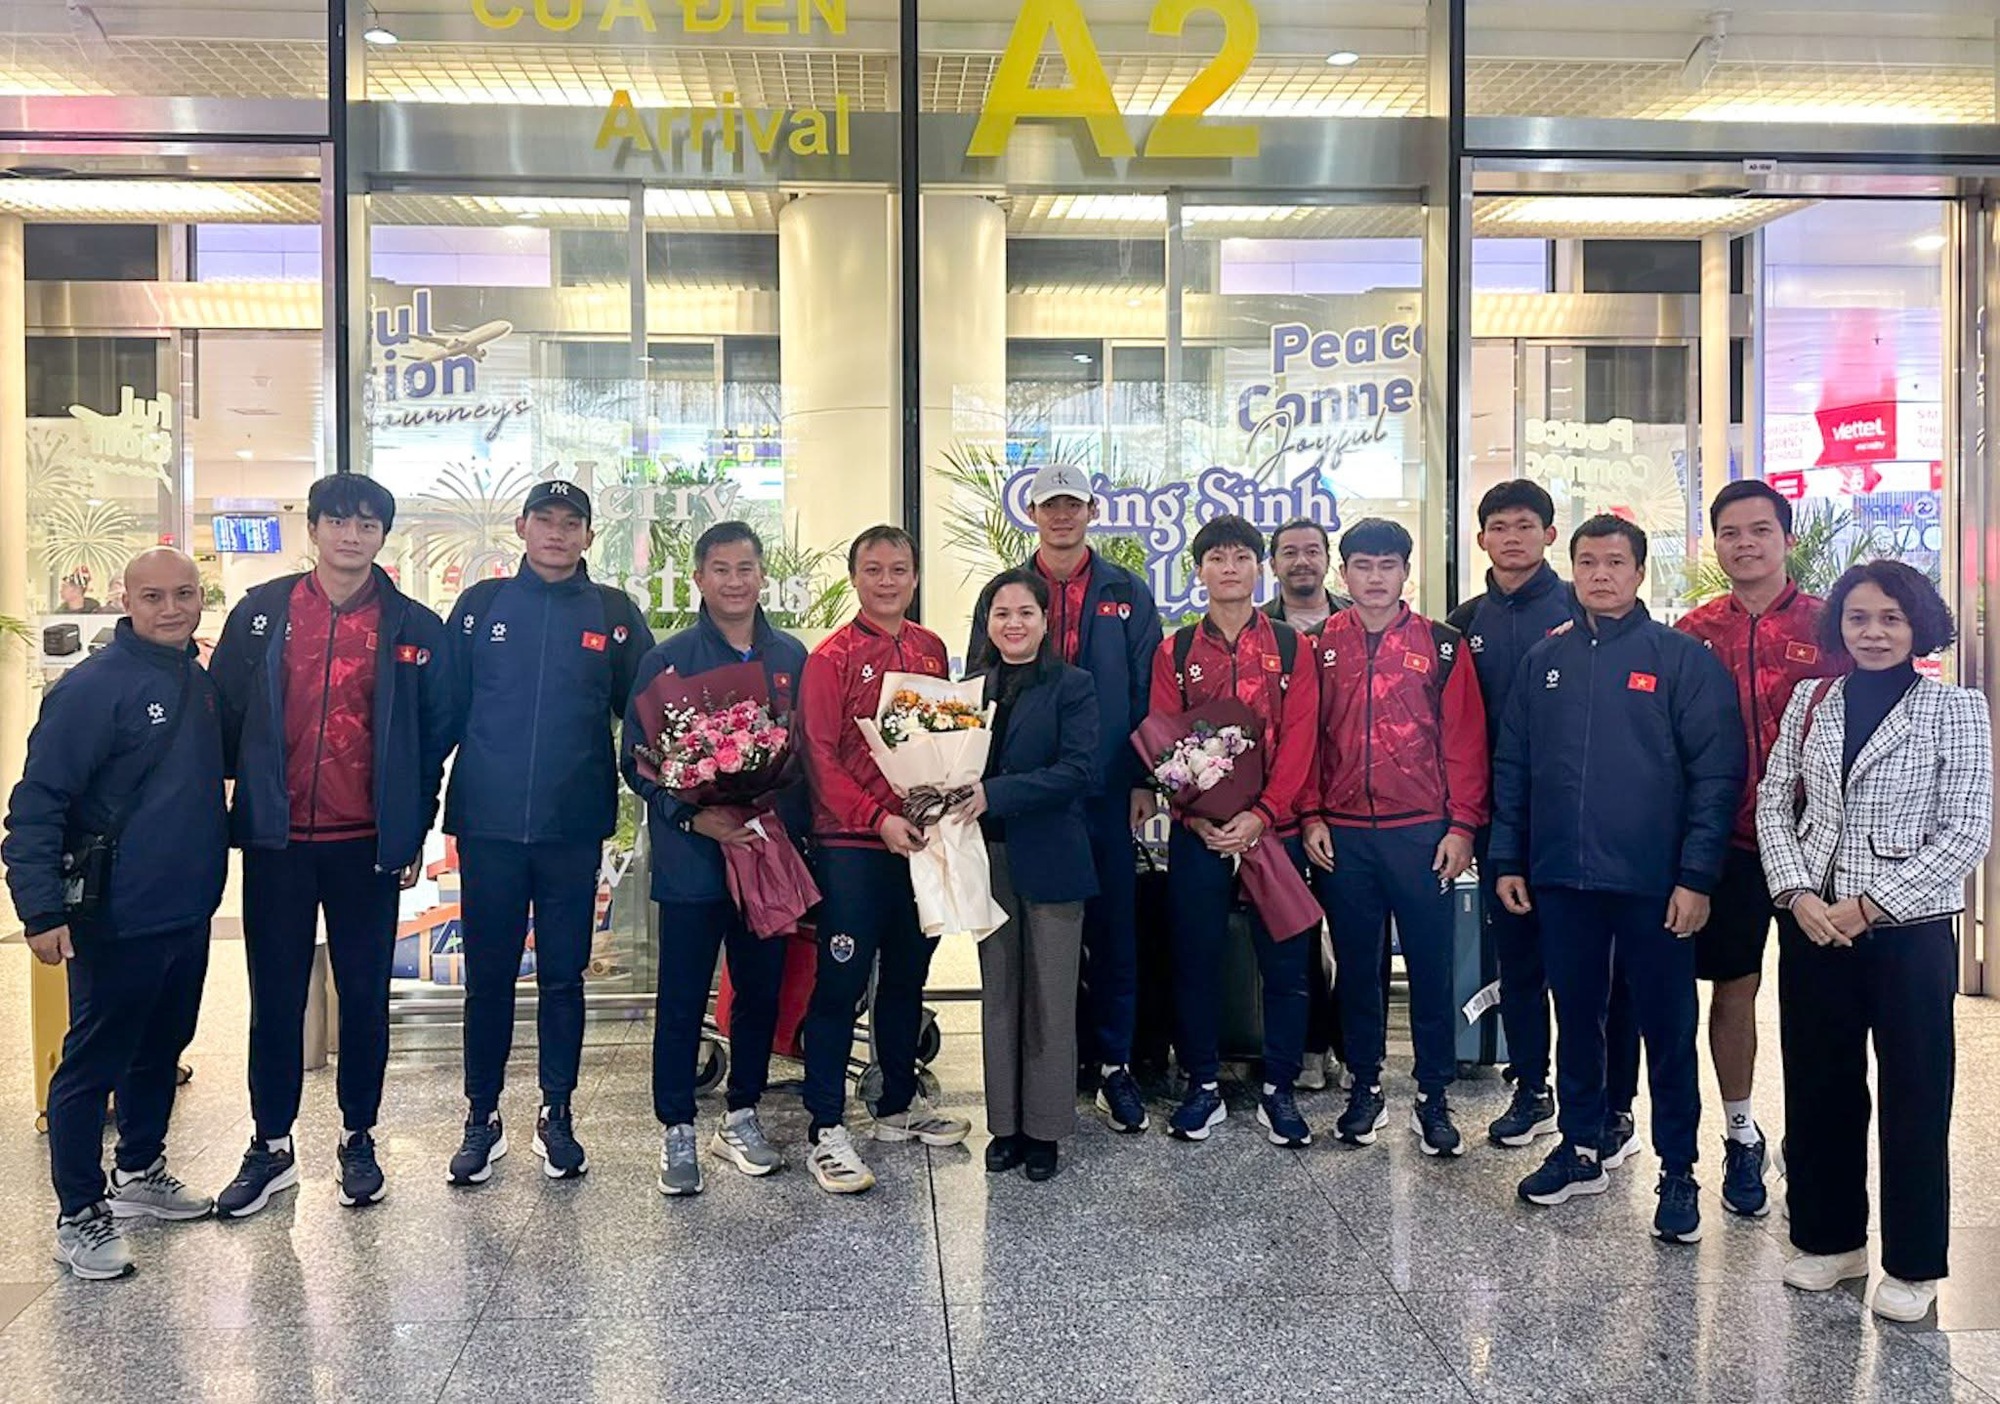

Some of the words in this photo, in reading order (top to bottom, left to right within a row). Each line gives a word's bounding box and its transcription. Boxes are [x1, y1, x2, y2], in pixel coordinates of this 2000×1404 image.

[966, 0, 1260, 157] A2
[594, 90, 850, 155] Arrival
[371, 288, 431, 347] ul
[372, 348, 477, 401] ion
